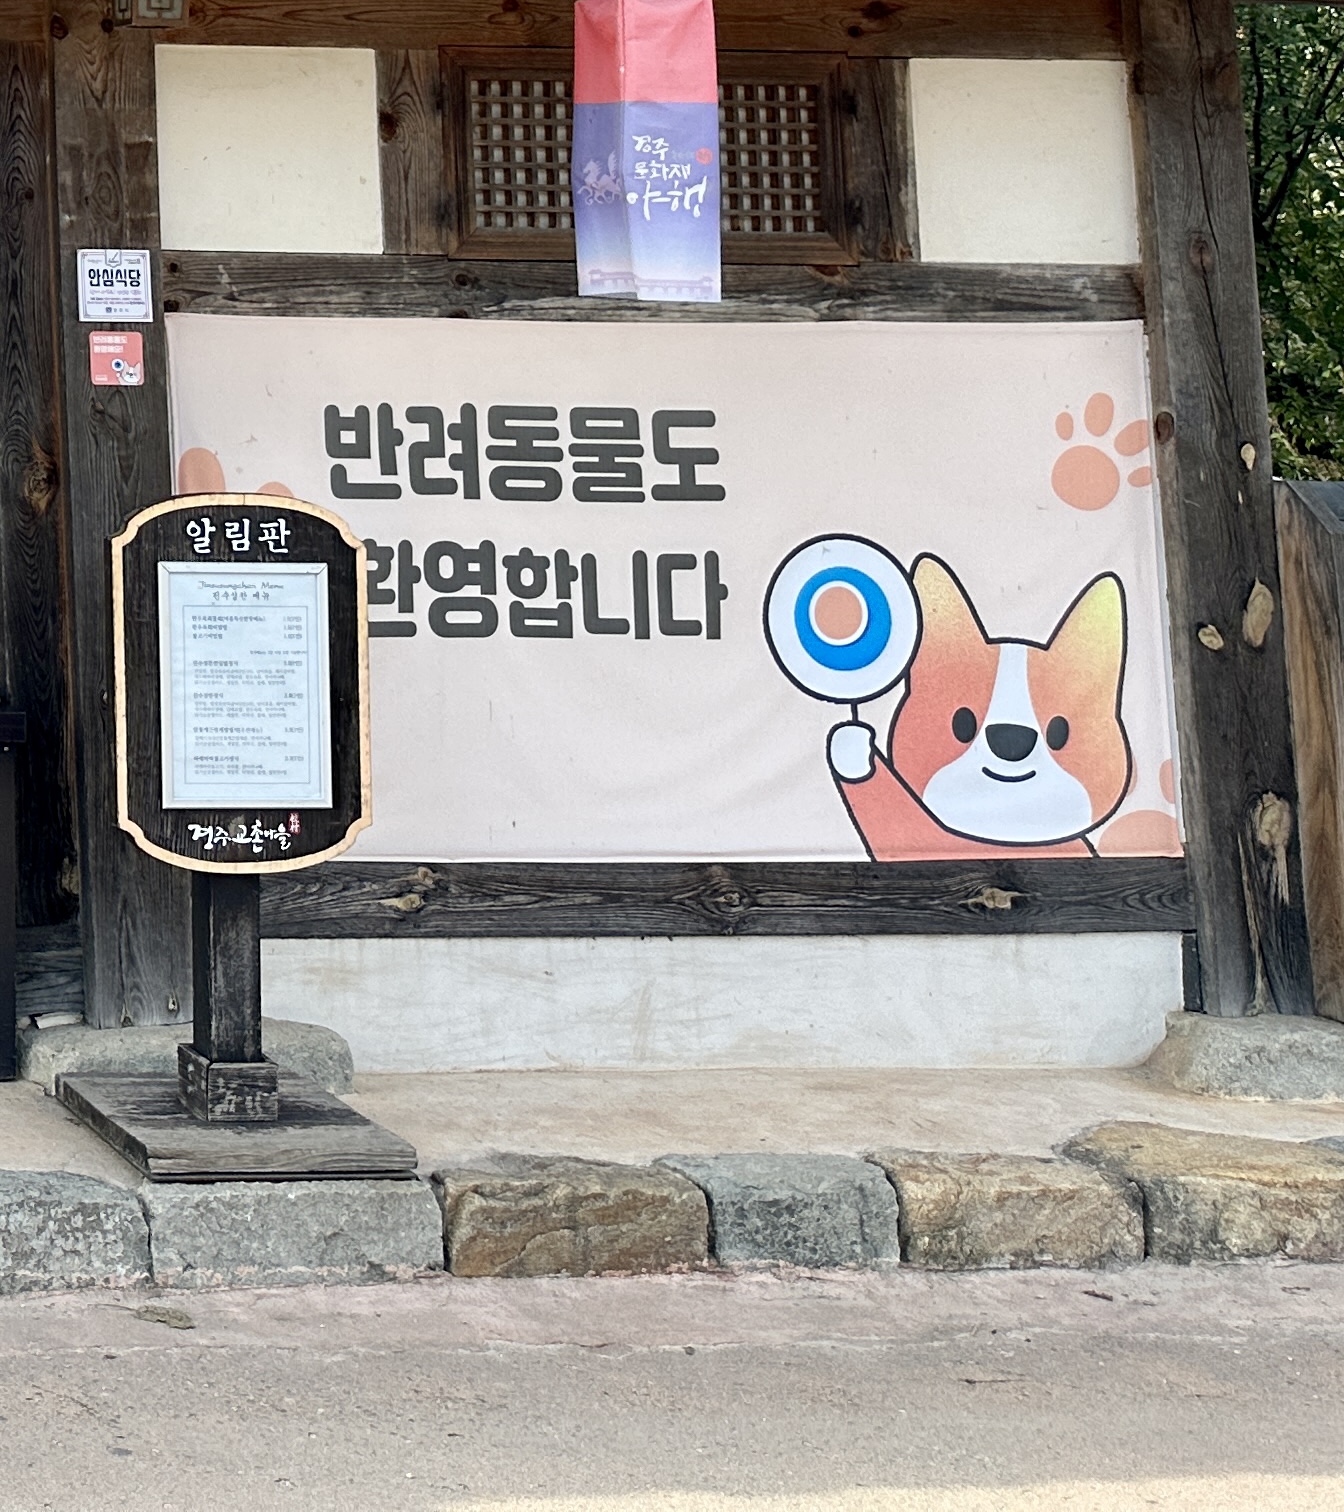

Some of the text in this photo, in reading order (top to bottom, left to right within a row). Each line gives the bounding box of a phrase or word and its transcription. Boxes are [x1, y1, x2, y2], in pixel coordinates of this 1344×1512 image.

[633, 159, 691, 181] 문화재
[88, 268, 141, 288] 안심식당
[323, 402, 727, 504] 반려동물도
[185, 517, 292, 554] 알림판
[365, 538, 729, 640] 환영합니다
